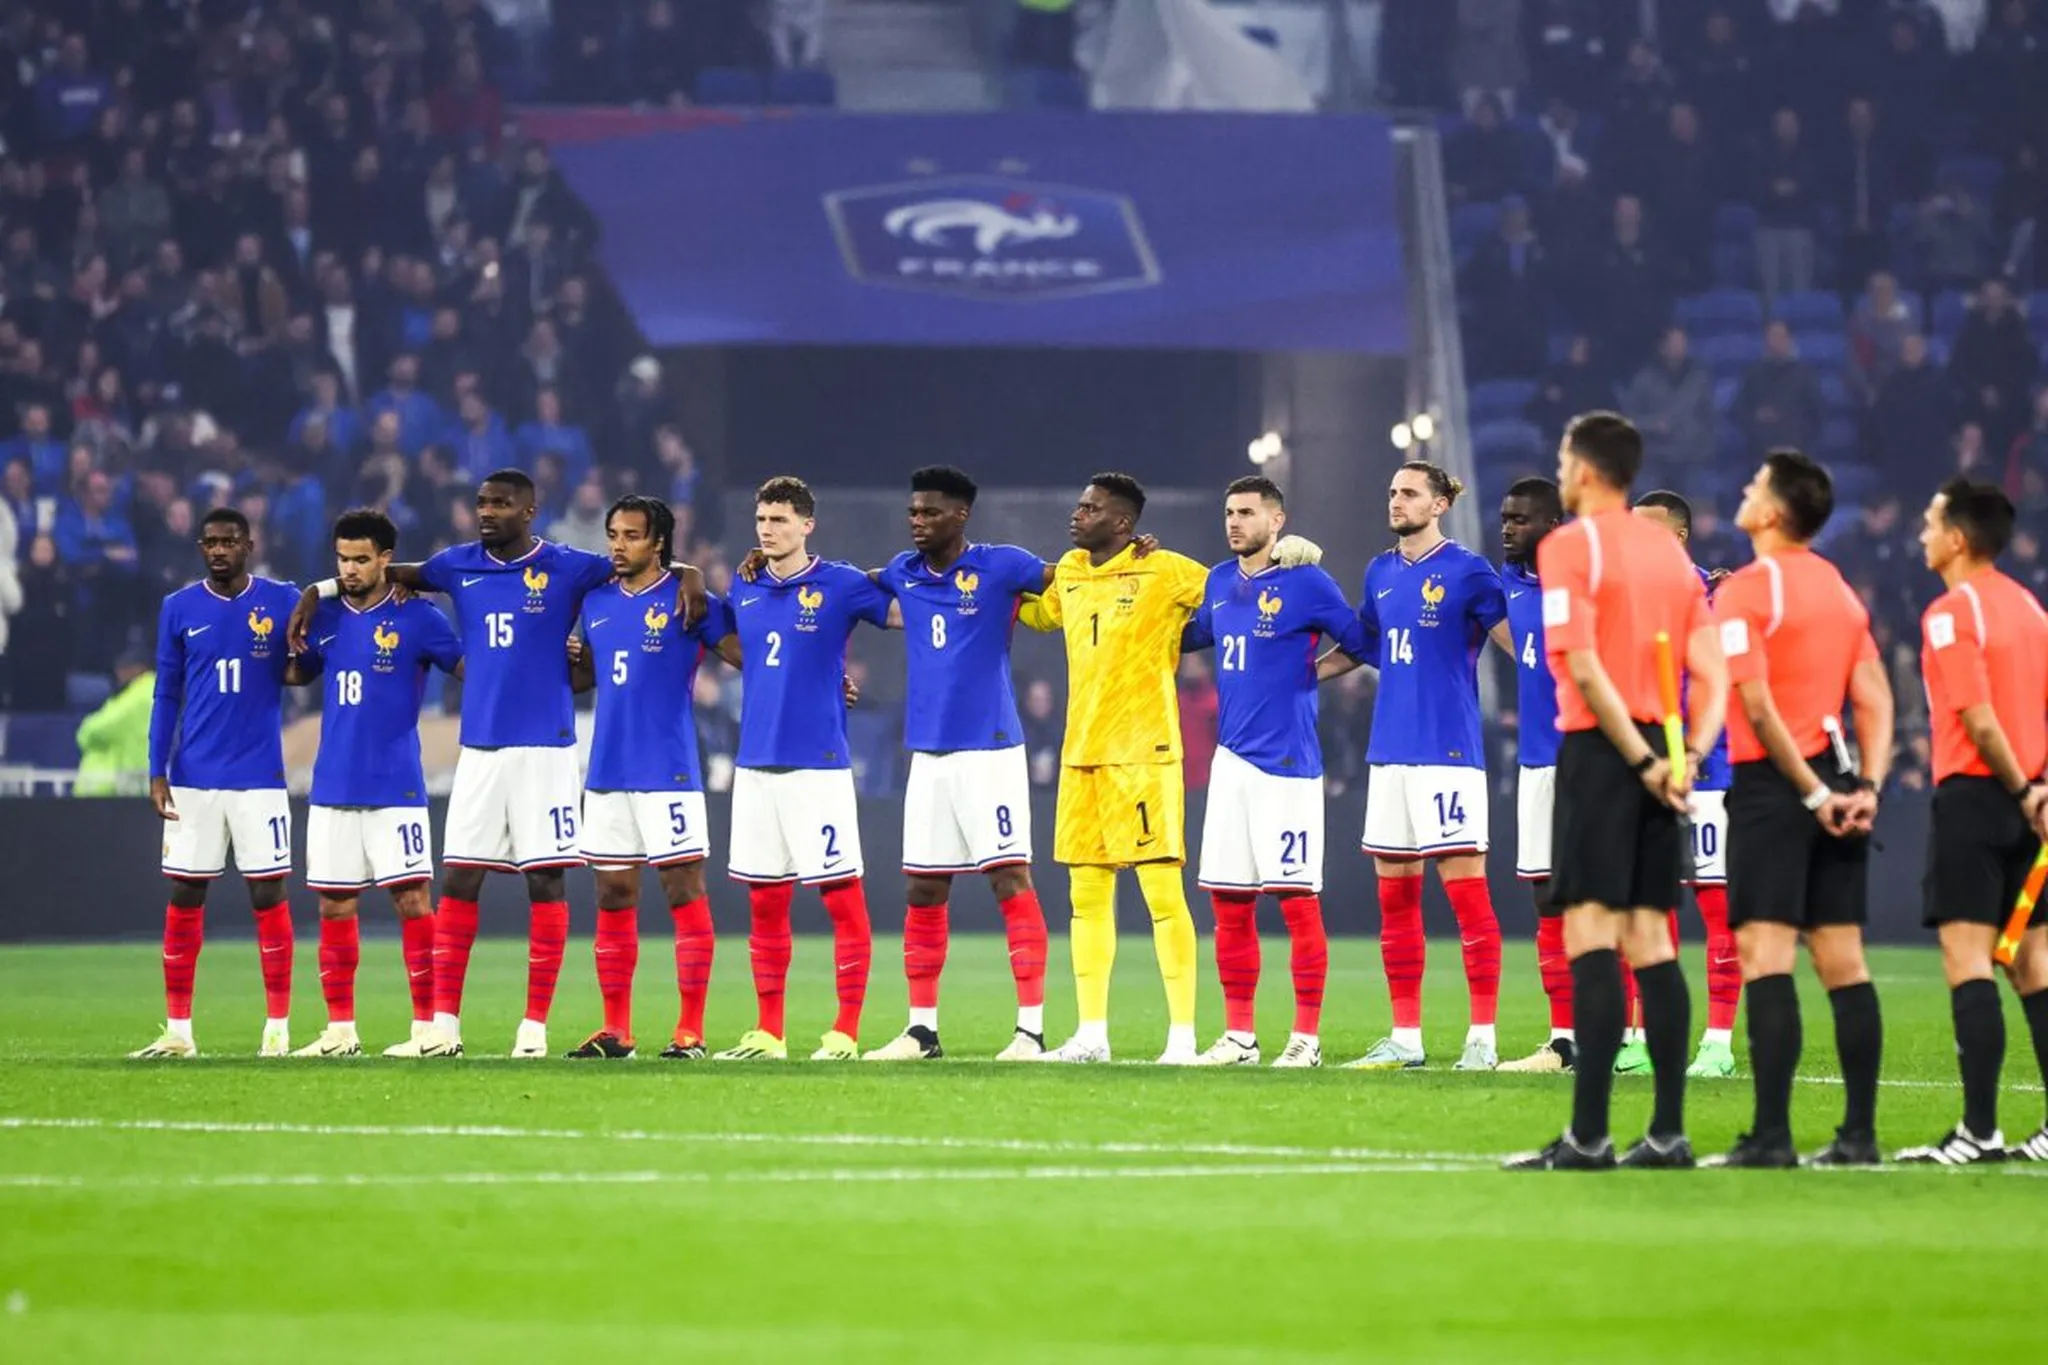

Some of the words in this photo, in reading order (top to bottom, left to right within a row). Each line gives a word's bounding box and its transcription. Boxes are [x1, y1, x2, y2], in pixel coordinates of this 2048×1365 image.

[485, 612, 514, 648] 15
[931, 614, 947, 649] 8
[1090, 612, 1099, 646] 1
[1387, 627, 1414, 665] 14
[765, 631, 781, 667] 2
[1222, 634, 1246, 671] 21
[1522, 632, 1537, 669] 4
[215, 658, 241, 693] 11
[612, 650, 629, 685] 5
[336, 670, 363, 706] 18
[549, 806, 575, 840] 15
[668, 801, 686, 835] 5
[996, 804, 1013, 838] 8
[1136, 801, 1149, 835] 1
[1433, 791, 1466, 826] 14
[268, 815, 288, 850] 11
[397, 822, 424, 856] 18
[821, 824, 840, 857] 2
[1280, 830, 1307, 864] 21
[1690, 822, 1716, 857] 10
